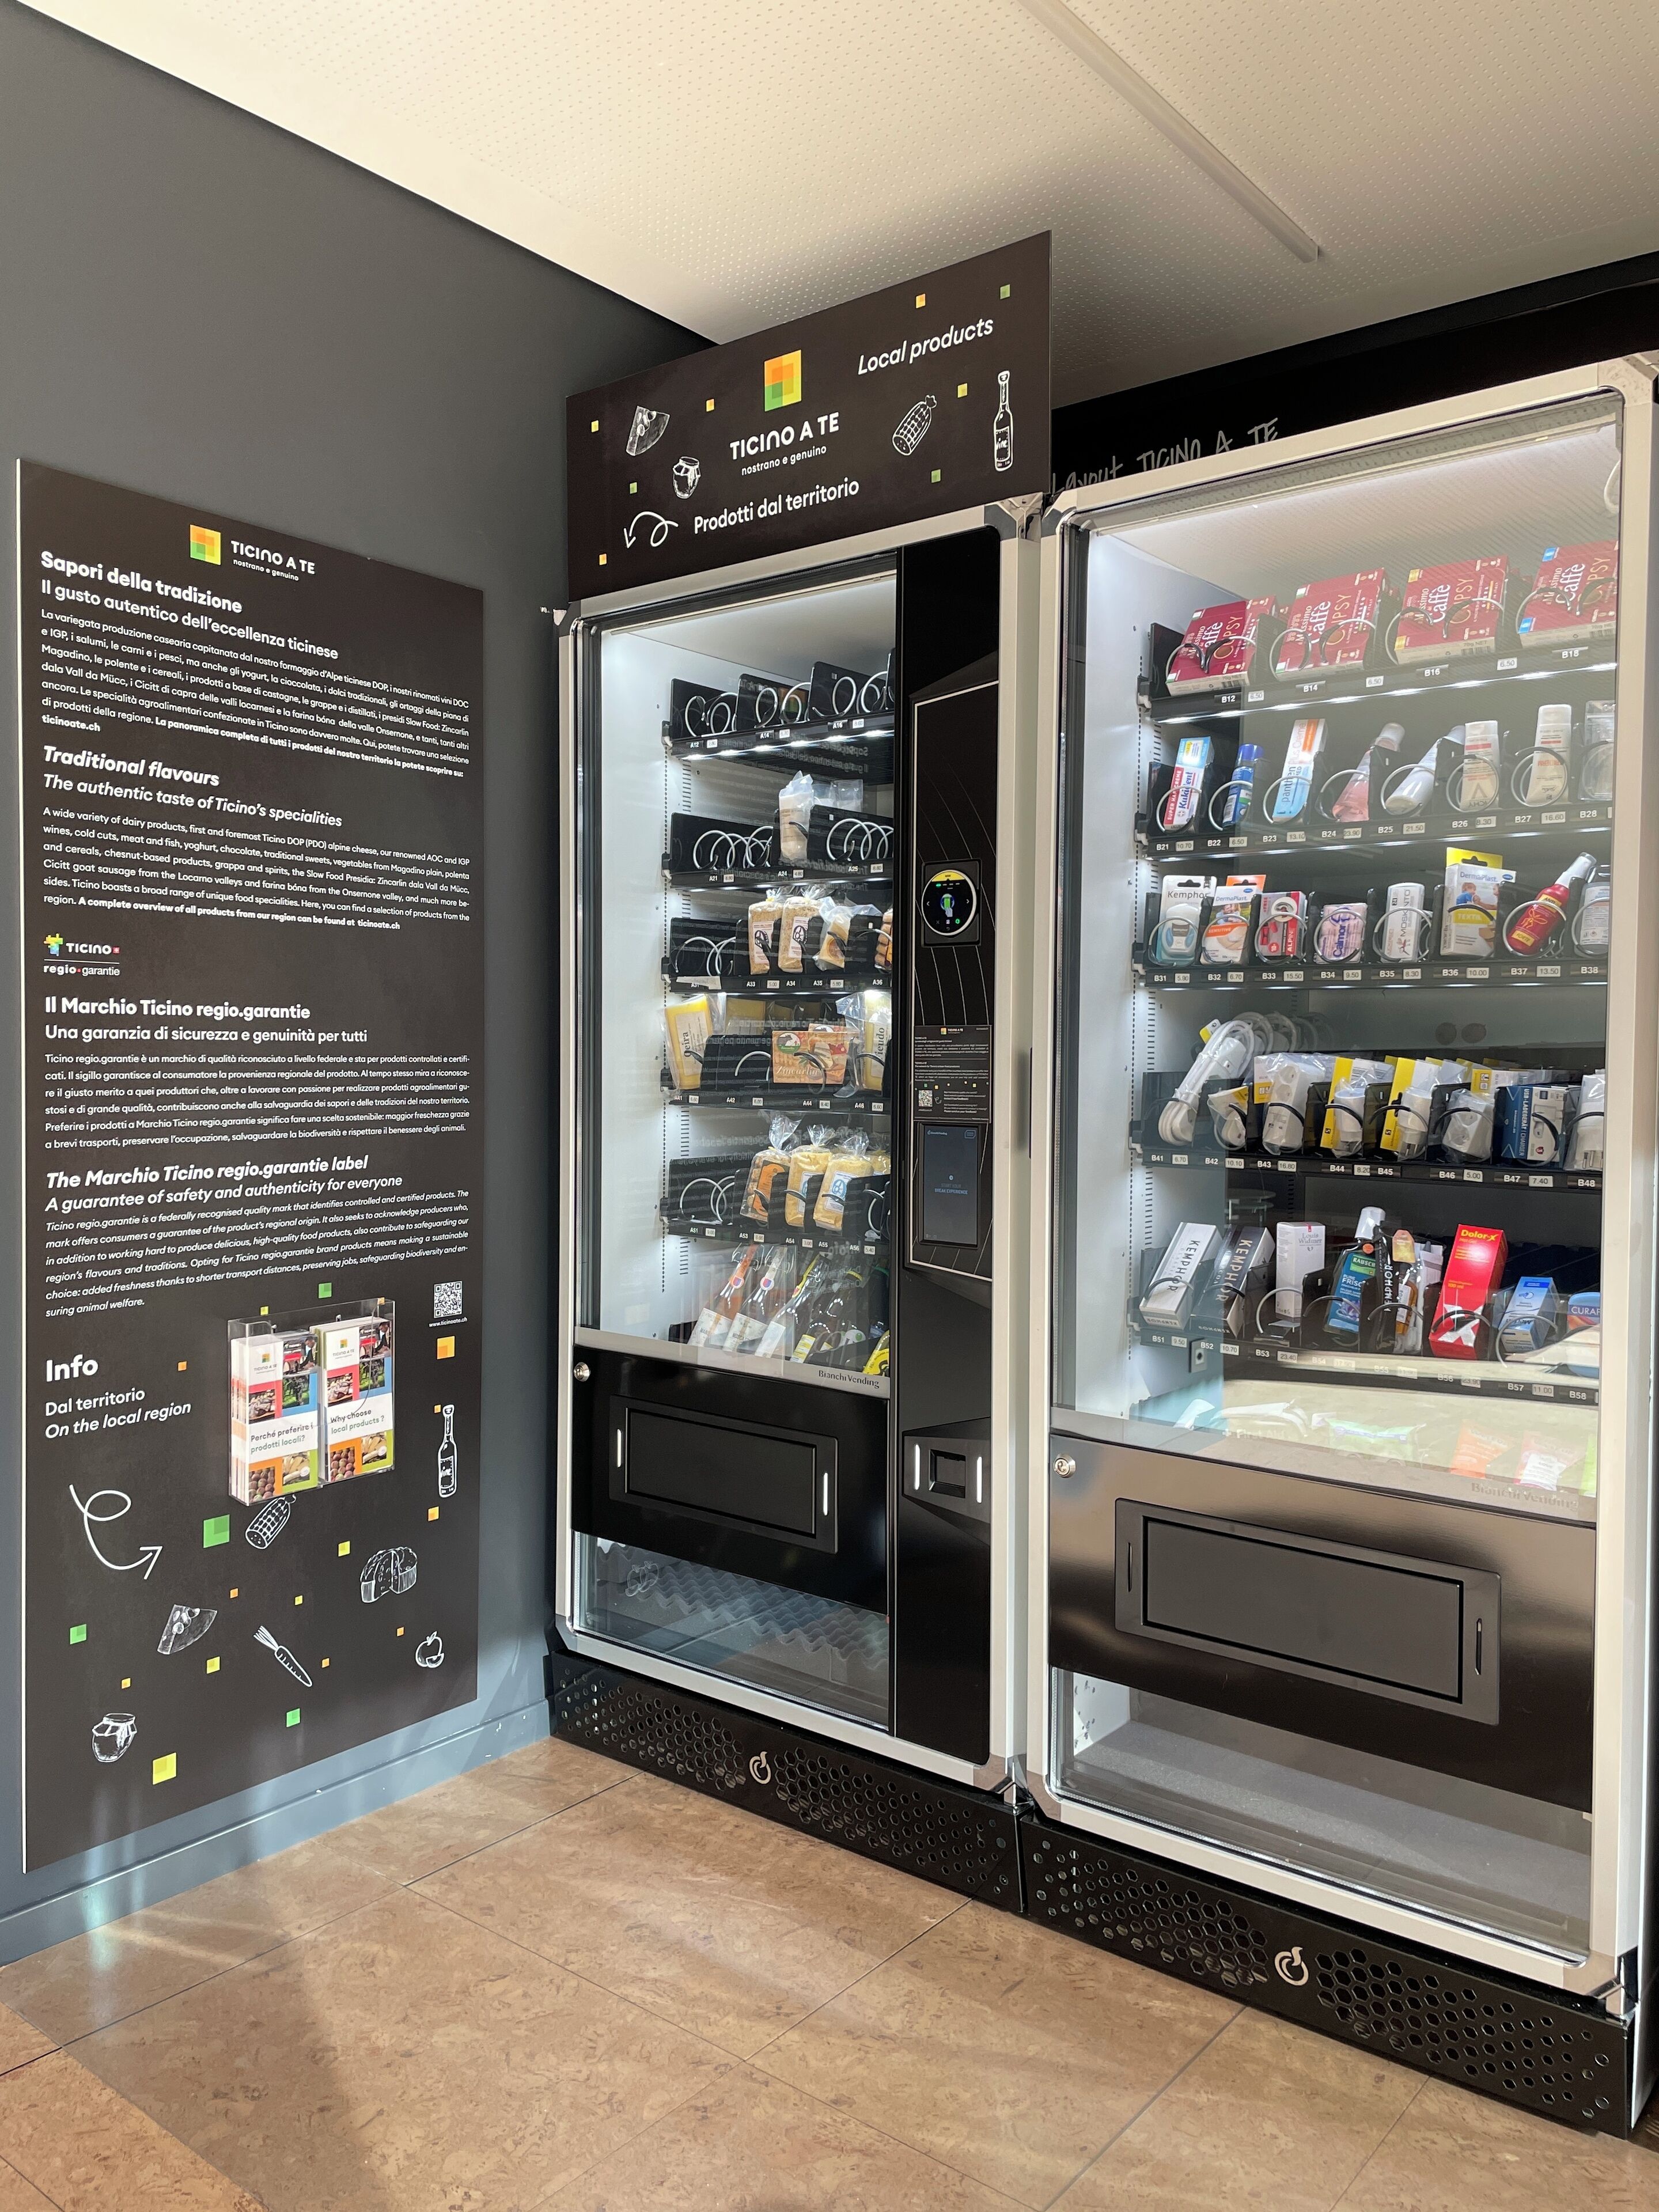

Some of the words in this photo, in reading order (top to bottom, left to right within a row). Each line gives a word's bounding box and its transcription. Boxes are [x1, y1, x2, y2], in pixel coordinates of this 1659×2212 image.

[858, 340, 907, 376] Local
[909, 318, 994, 365] products
[730, 425, 795, 460] TICINO
[799, 420, 813, 442] A
[817, 411, 839, 435] TE
[1137, 438, 1200, 471] TICINO
[1216, 431, 1233, 454] A
[1248, 418, 1278, 444] TE
[741, 458, 781, 476] nostrano
[782, 456, 788, 465] e
[790, 445, 827, 465] genuino
[694, 501, 753, 535] Prodotti
[757, 494, 782, 518] dal
[785, 476, 859, 512] territorio
[230, 540, 283, 566] TICINO
[286, 556, 297, 570] A
[299, 559, 315, 575] TE
[233, 559, 264, 573] nostrano
[271, 569, 299, 582] genuino
[41, 550, 103, 581] Sapori
[107, 567, 152, 593] della
[155, 579, 243, 613] tradizione
[41, 578, 51, 595] Il
[54, 585, 101, 606] gusto
[104, 597, 179, 623] autentico
[181, 612, 285, 647] dell'eccellenza
[287, 637, 338, 660] ticinese
[1562, 650, 1578, 658] B18
[1424, 668, 1440, 676] B16
[1221, 694, 1236, 703] B12
[1304, 684, 1318, 692] B14
[41, 714, 101, 732] ticinoate.ch
[43, 744, 146, 776] Traditional
[148, 760, 219, 787] flavours
[44, 773, 74, 791] The
[77, 781, 153, 802] authentic
[156, 790, 195, 807] taste
[197, 795, 214, 810] of
[215, 797, 266, 817] Ticino's
[268, 808, 342, 827] specialities
[1460, 871, 1497, 883] DermaPlast
[1215, 894, 1247, 903] DermaPlast
[1400, 889, 1411, 938] MOSKNTO
[1457, 912, 1482, 922] TEXTIL
[66, 942, 111, 955] TICINO
[1286, 927, 1295, 953] ALPINE
[1333, 923, 1346, 958] Calmor
[46, 995, 56, 1013] Il
[61, 997, 137, 1016] Marchio
[139, 999, 193, 1017] Ticino
[196, 1001, 310, 1022] regio.garantie
[46, 1024, 78, 1039] Una
[82, 1025, 151, 1043] garanzia
[154, 1025, 168, 1040] di
[171, 1026, 238, 1041] sicurezza
[241, 1031, 250, 1041] e
[252, 1028, 315, 1045] genuinità
[318, 1032, 340, 1045] per
[340, 1029, 368, 1042] tutti
[47, 1171, 81, 1189] The
[85, 1166, 160, 1187] Marchio
[163, 1164, 214, 1181] Ticino
[217, 1157, 329, 1181] regio.garantie
[331, 1154, 369, 1171] label
[44, 1196, 58, 1212] A
[61, 1193, 145, 1214] guarantee
[147, 1188, 165, 1205] of
[165, 1187, 213, 1204] safety
[214, 1184, 243, 1200] and
[244, 1179, 326, 1197] authenticity
[327, 1177, 346, 1191] for
[347, 1177, 403, 1191] everyone
[1166, 1239, 1200, 1292] KEMPHOR
[1216, 1238, 1252, 1303] KEMPHOR
[1353, 1257, 1376, 1268] RAUSCH
[46, 1305, 75, 1317] suring
[76, 1300, 109, 1313] animal
[109, 1298, 145, 1309] welfare.
[429, 1316, 468, 1328] www.ticinoate.ch
[46, 1354, 99, 1382] Info
[819, 1369, 847, 1383] Bianchi
[847, 1373, 880, 1388] Vending
[1508, 1383, 1524, 1391] B57
[46, 1397, 73, 1416] Dal
[75, 1387, 145, 1411] territorio
[45, 1423, 70, 1439] On
[73, 1418, 100, 1434] the
[103, 1407, 142, 1429] local
[143, 1402, 191, 1422] region
[330, 1414, 346, 1423] Why
[346, 1409, 372, 1421] choose
[331, 1426, 347, 1435] local
[349, 1417, 380, 1431] products
[251, 1431, 275, 1442] Perché
[277, 1425, 309, 1437] preferire
[251, 1441, 281, 1455] prodotti
[281, 1434, 305, 1446] locali?
